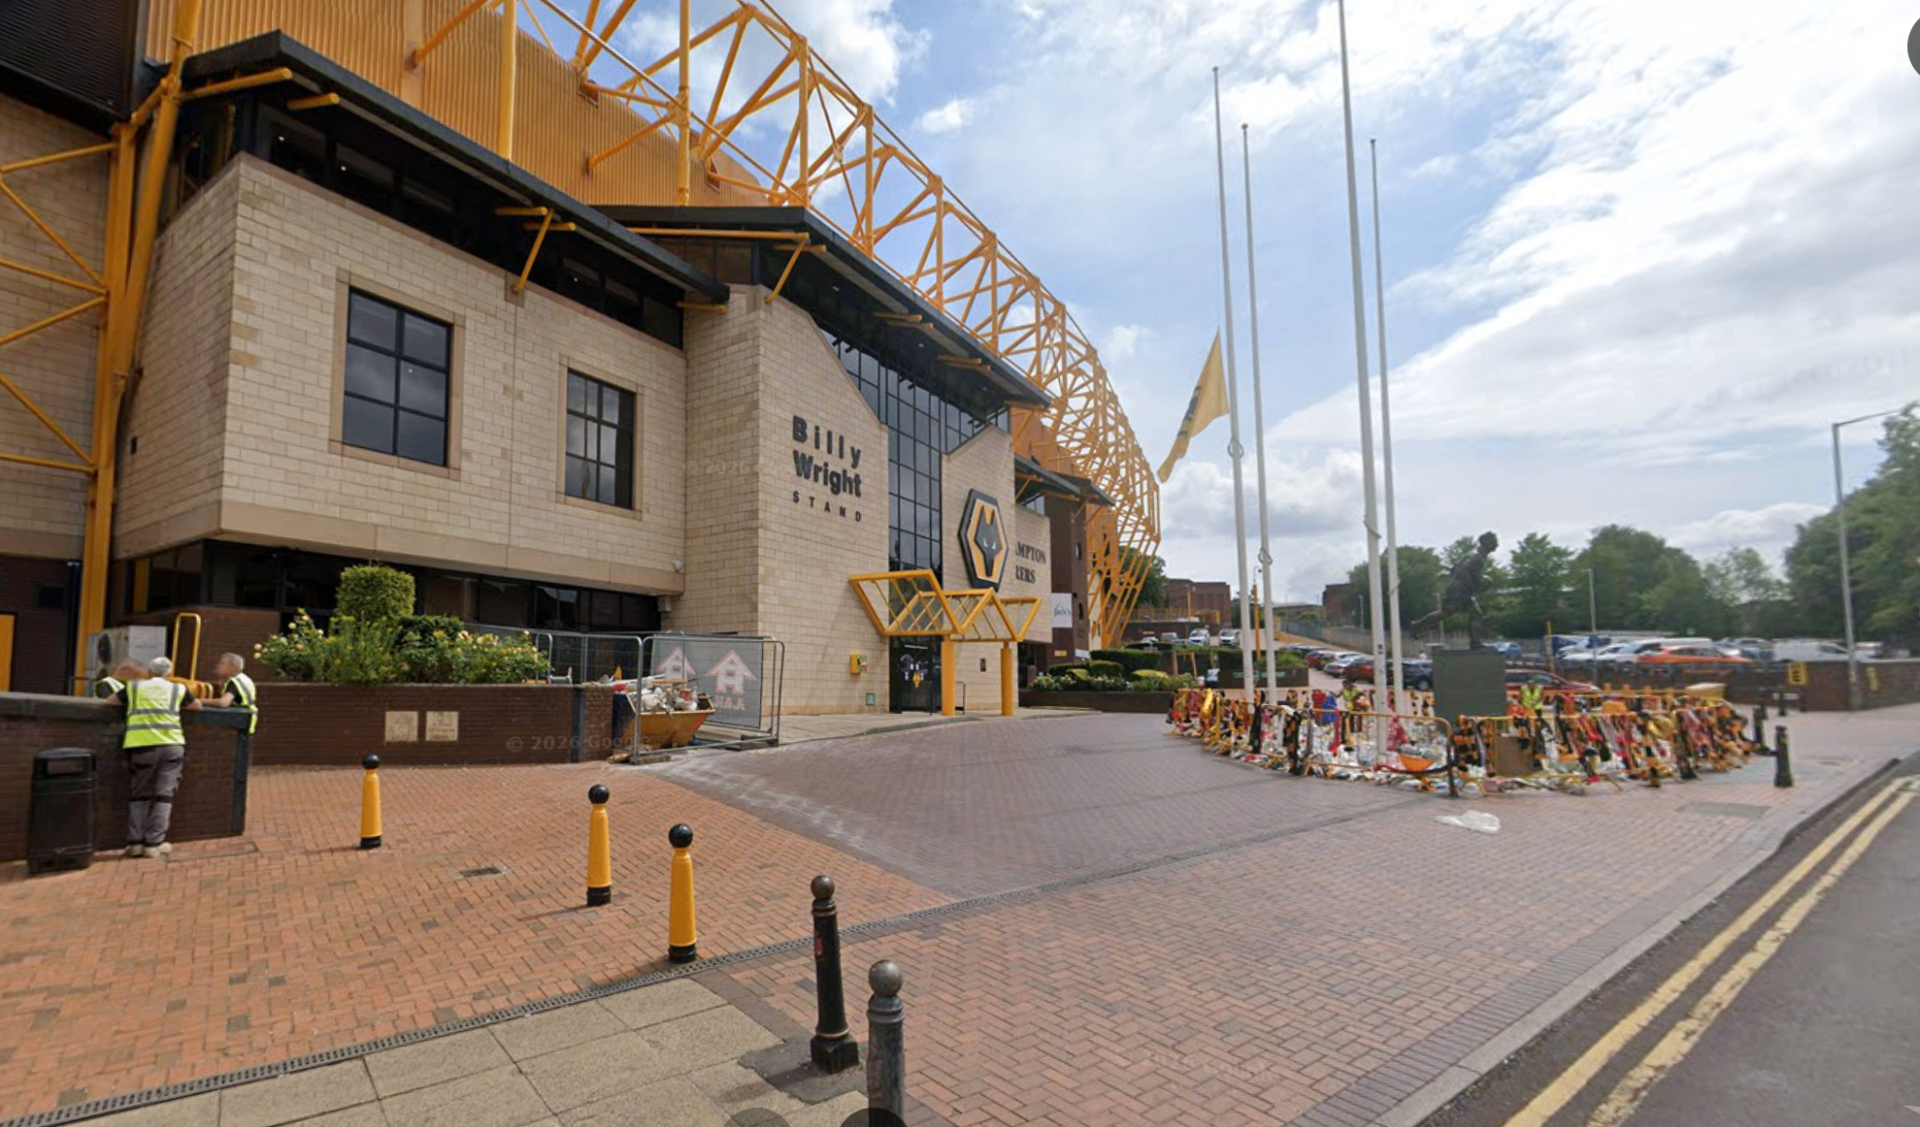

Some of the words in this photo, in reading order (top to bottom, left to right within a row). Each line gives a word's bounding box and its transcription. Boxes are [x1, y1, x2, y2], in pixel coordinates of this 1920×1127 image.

[793, 415, 862, 469] Billy
[793, 449, 862, 498] Wright
[793, 490, 861, 522] STAND
